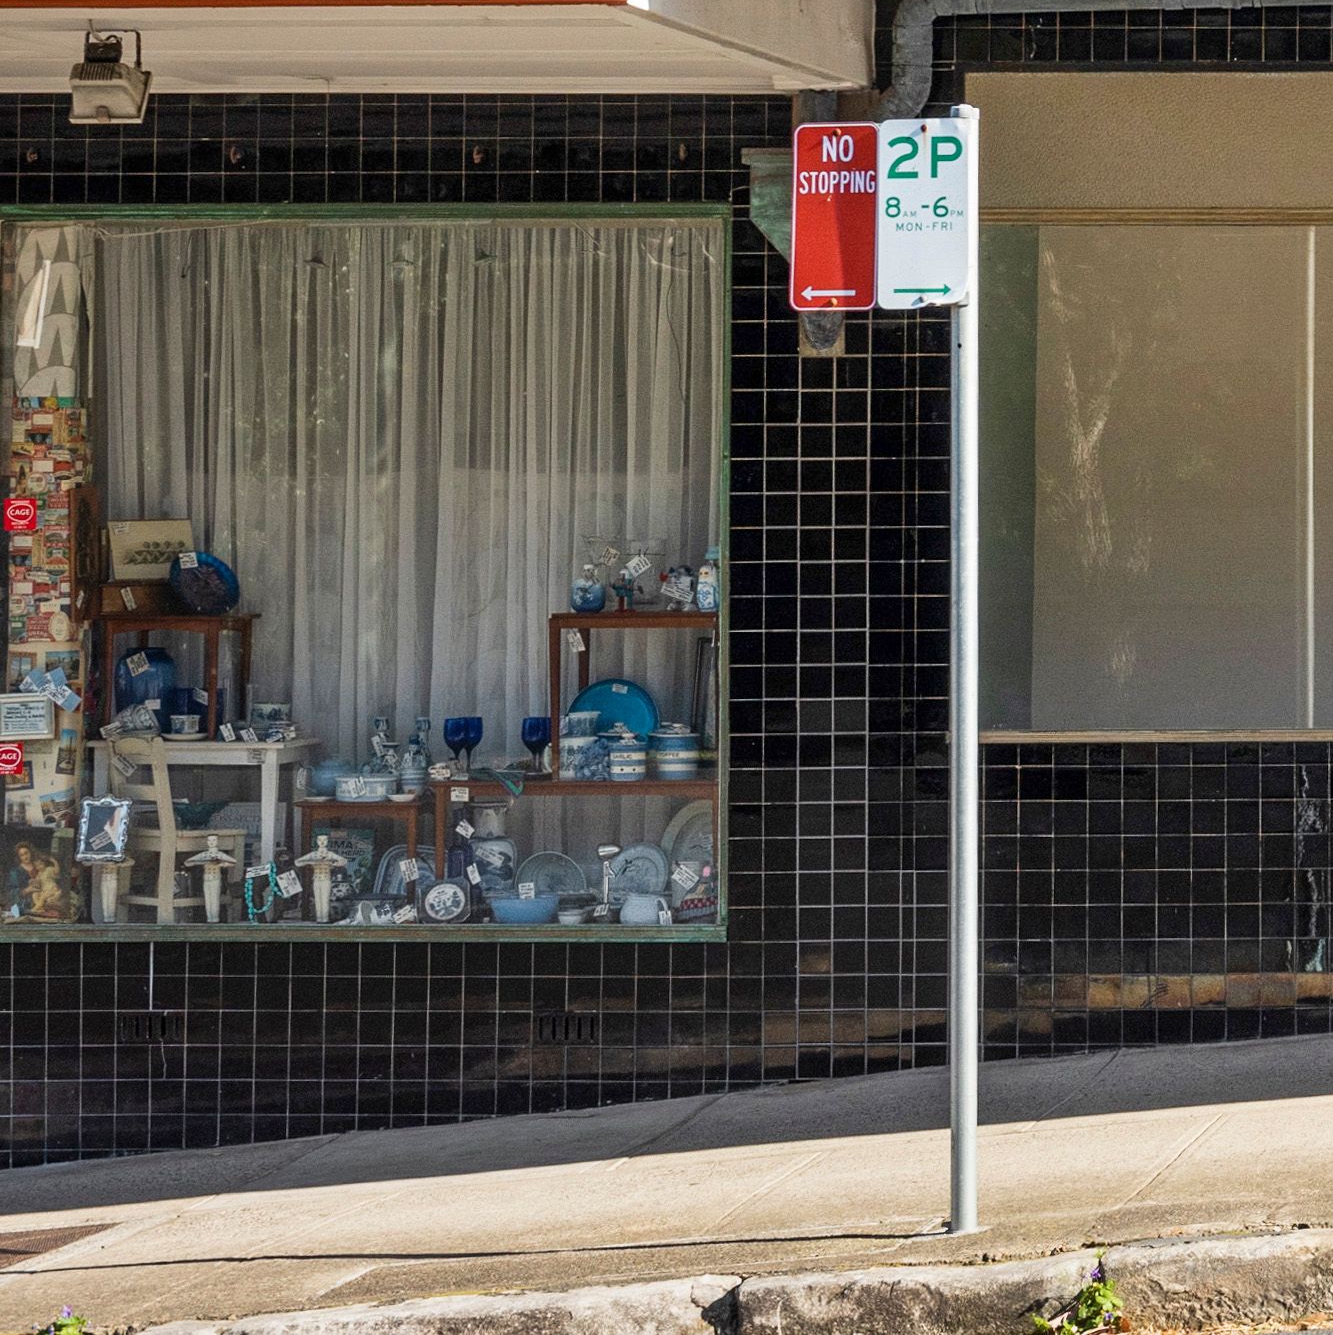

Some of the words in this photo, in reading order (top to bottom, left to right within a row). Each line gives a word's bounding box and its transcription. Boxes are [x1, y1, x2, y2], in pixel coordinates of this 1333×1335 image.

[822, 134, 855, 163] NO
[887, 135, 963, 179] 2P
[798, 170, 877, 195] STOPPING
[9, 508, 30, 516] CAGE
